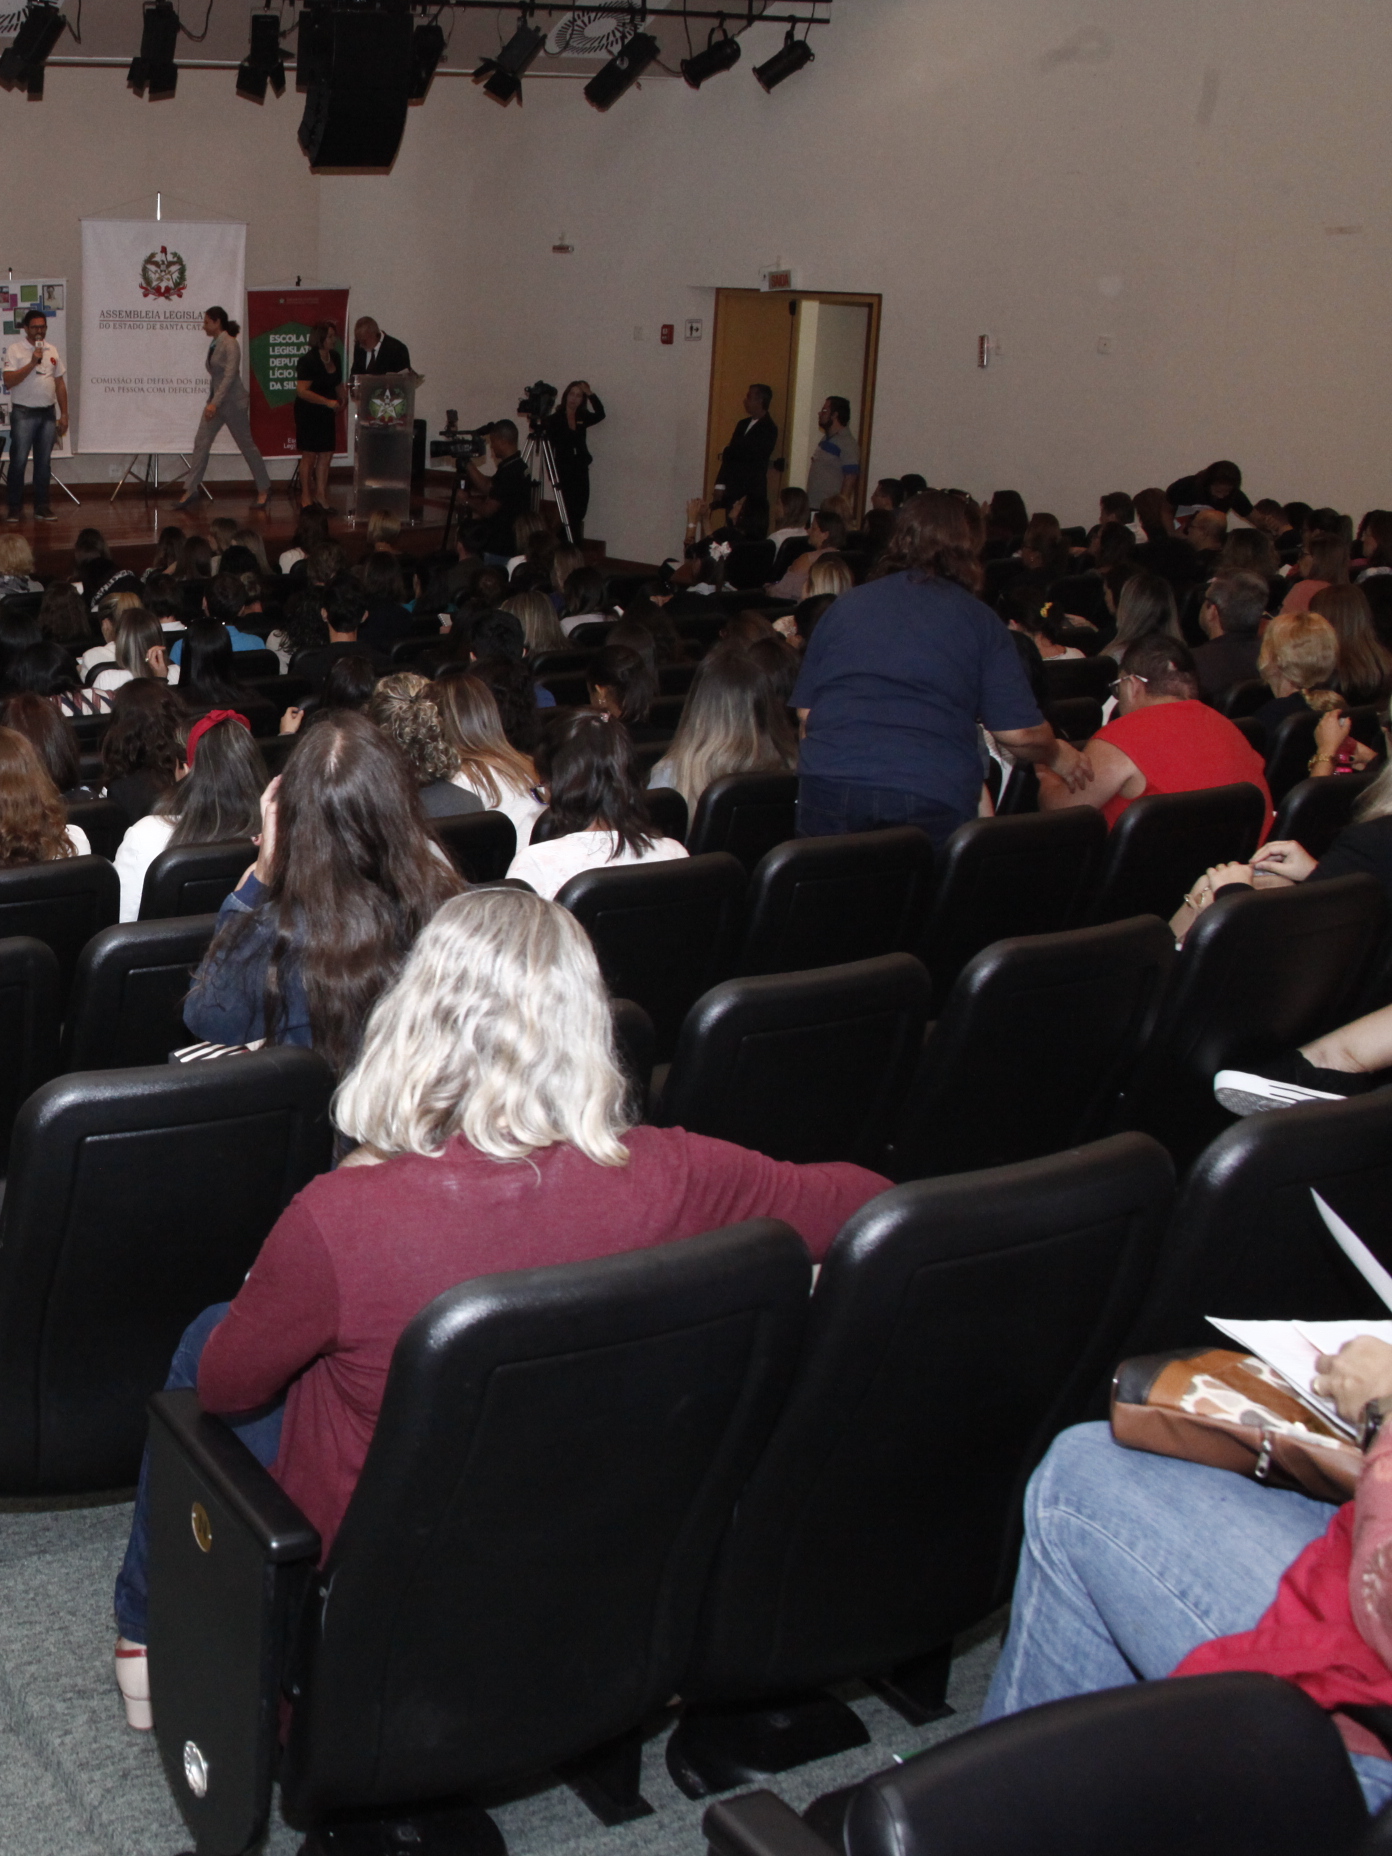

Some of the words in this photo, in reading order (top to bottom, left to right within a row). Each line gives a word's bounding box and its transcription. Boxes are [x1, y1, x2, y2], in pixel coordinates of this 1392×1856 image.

[99, 310, 161, 320] ASSEMBLEIA
[99, 322, 111, 330] DO
[113, 322, 144, 330] ESTADO
[146, 323, 157, 331] DE
[159, 323, 184, 331] SANTA
[269, 334, 305, 343] ESCOLA
[269, 346, 312, 356] LEGISLAT
[269, 368, 294, 379] LÍCIO
[90, 376, 132, 385] COMISSÃO
[134, 377, 144, 385] DE
[146, 377, 174, 386] DEFESA
[176, 378, 193, 386] DOS
[195, 378, 212, 386] DIR
[269, 381, 282, 390] DA
[104, 386, 115, 394] DA
[117, 386, 145, 394] PESSOA
[146, 386, 166, 394] COM
